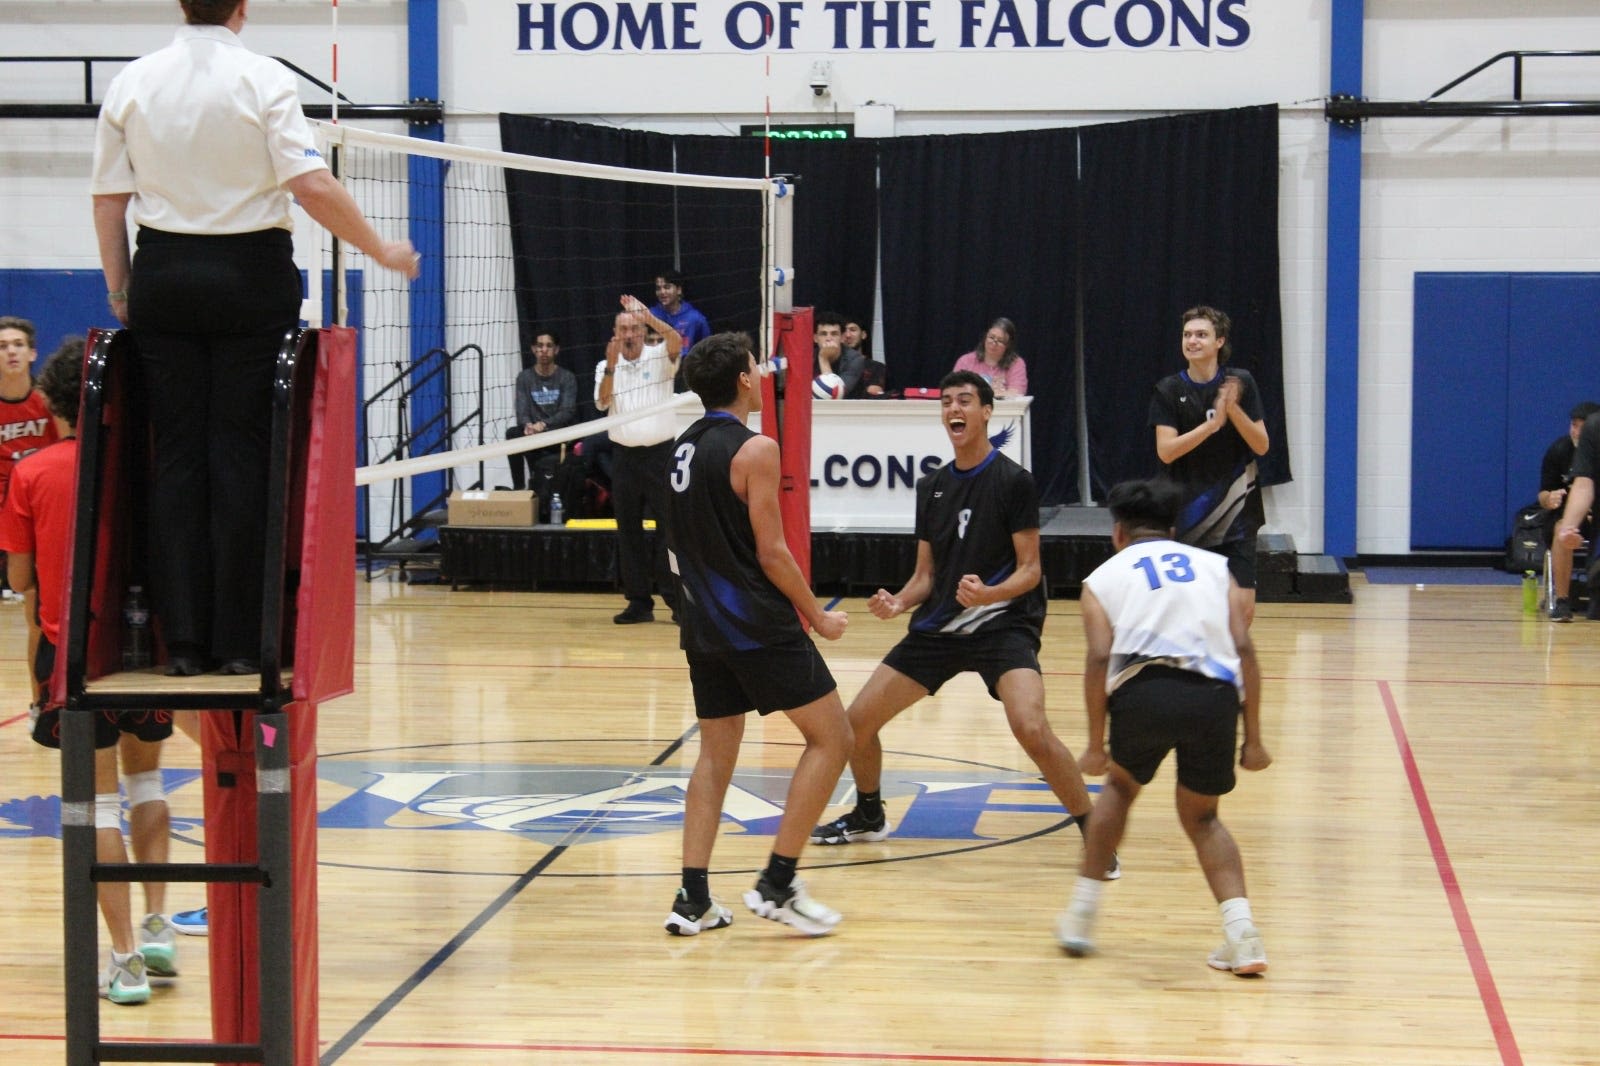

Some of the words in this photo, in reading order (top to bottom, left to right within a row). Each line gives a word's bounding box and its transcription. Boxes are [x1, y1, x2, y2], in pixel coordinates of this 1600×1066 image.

[516, 1, 701, 50] HOME
[725, 1, 803, 50] OF
[824, 1, 936, 49] THE
[959, 0, 1251, 48] FALCONS
[0, 418, 48, 445] HEAT
[670, 442, 696, 493] 3
[1132, 553, 1195, 590] 13
